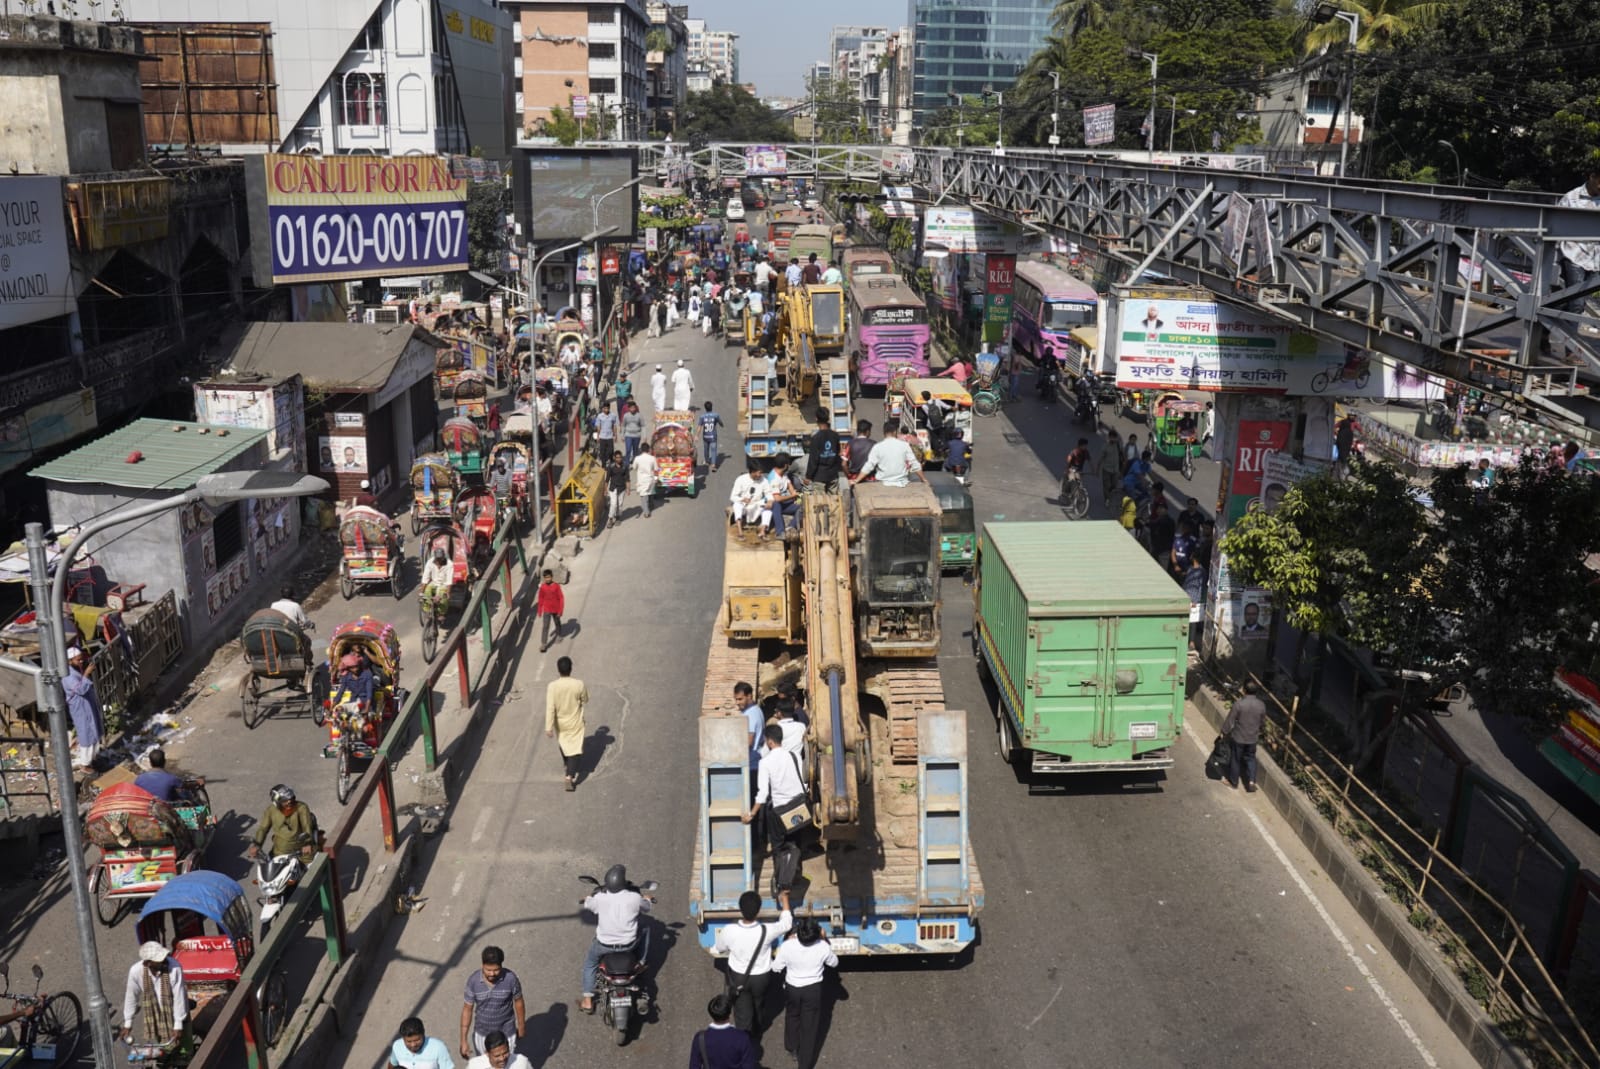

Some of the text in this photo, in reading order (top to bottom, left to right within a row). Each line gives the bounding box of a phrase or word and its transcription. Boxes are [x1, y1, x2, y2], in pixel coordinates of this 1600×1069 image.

[273, 161, 357, 194] CALL
[363, 162, 420, 193] FOR
[0, 200, 40, 227] YOUR
[16, 229, 43, 246] SPACE
[275, 209, 465, 269] 01620-001707
[0, 253, 11, 272] @
[989, 270, 1012, 283] RICL
[1176, 320, 1211, 333] আসন্ন
[1168, 334, 1212, 344] ঢাকা-১০
[1146, 348, 1194, 357] বাংলাদেশ
[1129, 364, 1175, 378] মুফতি
[1180, 365, 1234, 380] ইলিয়াস
[1239, 368, 1288, 383] হামিদী
[1238, 447, 1279, 472] RIC
